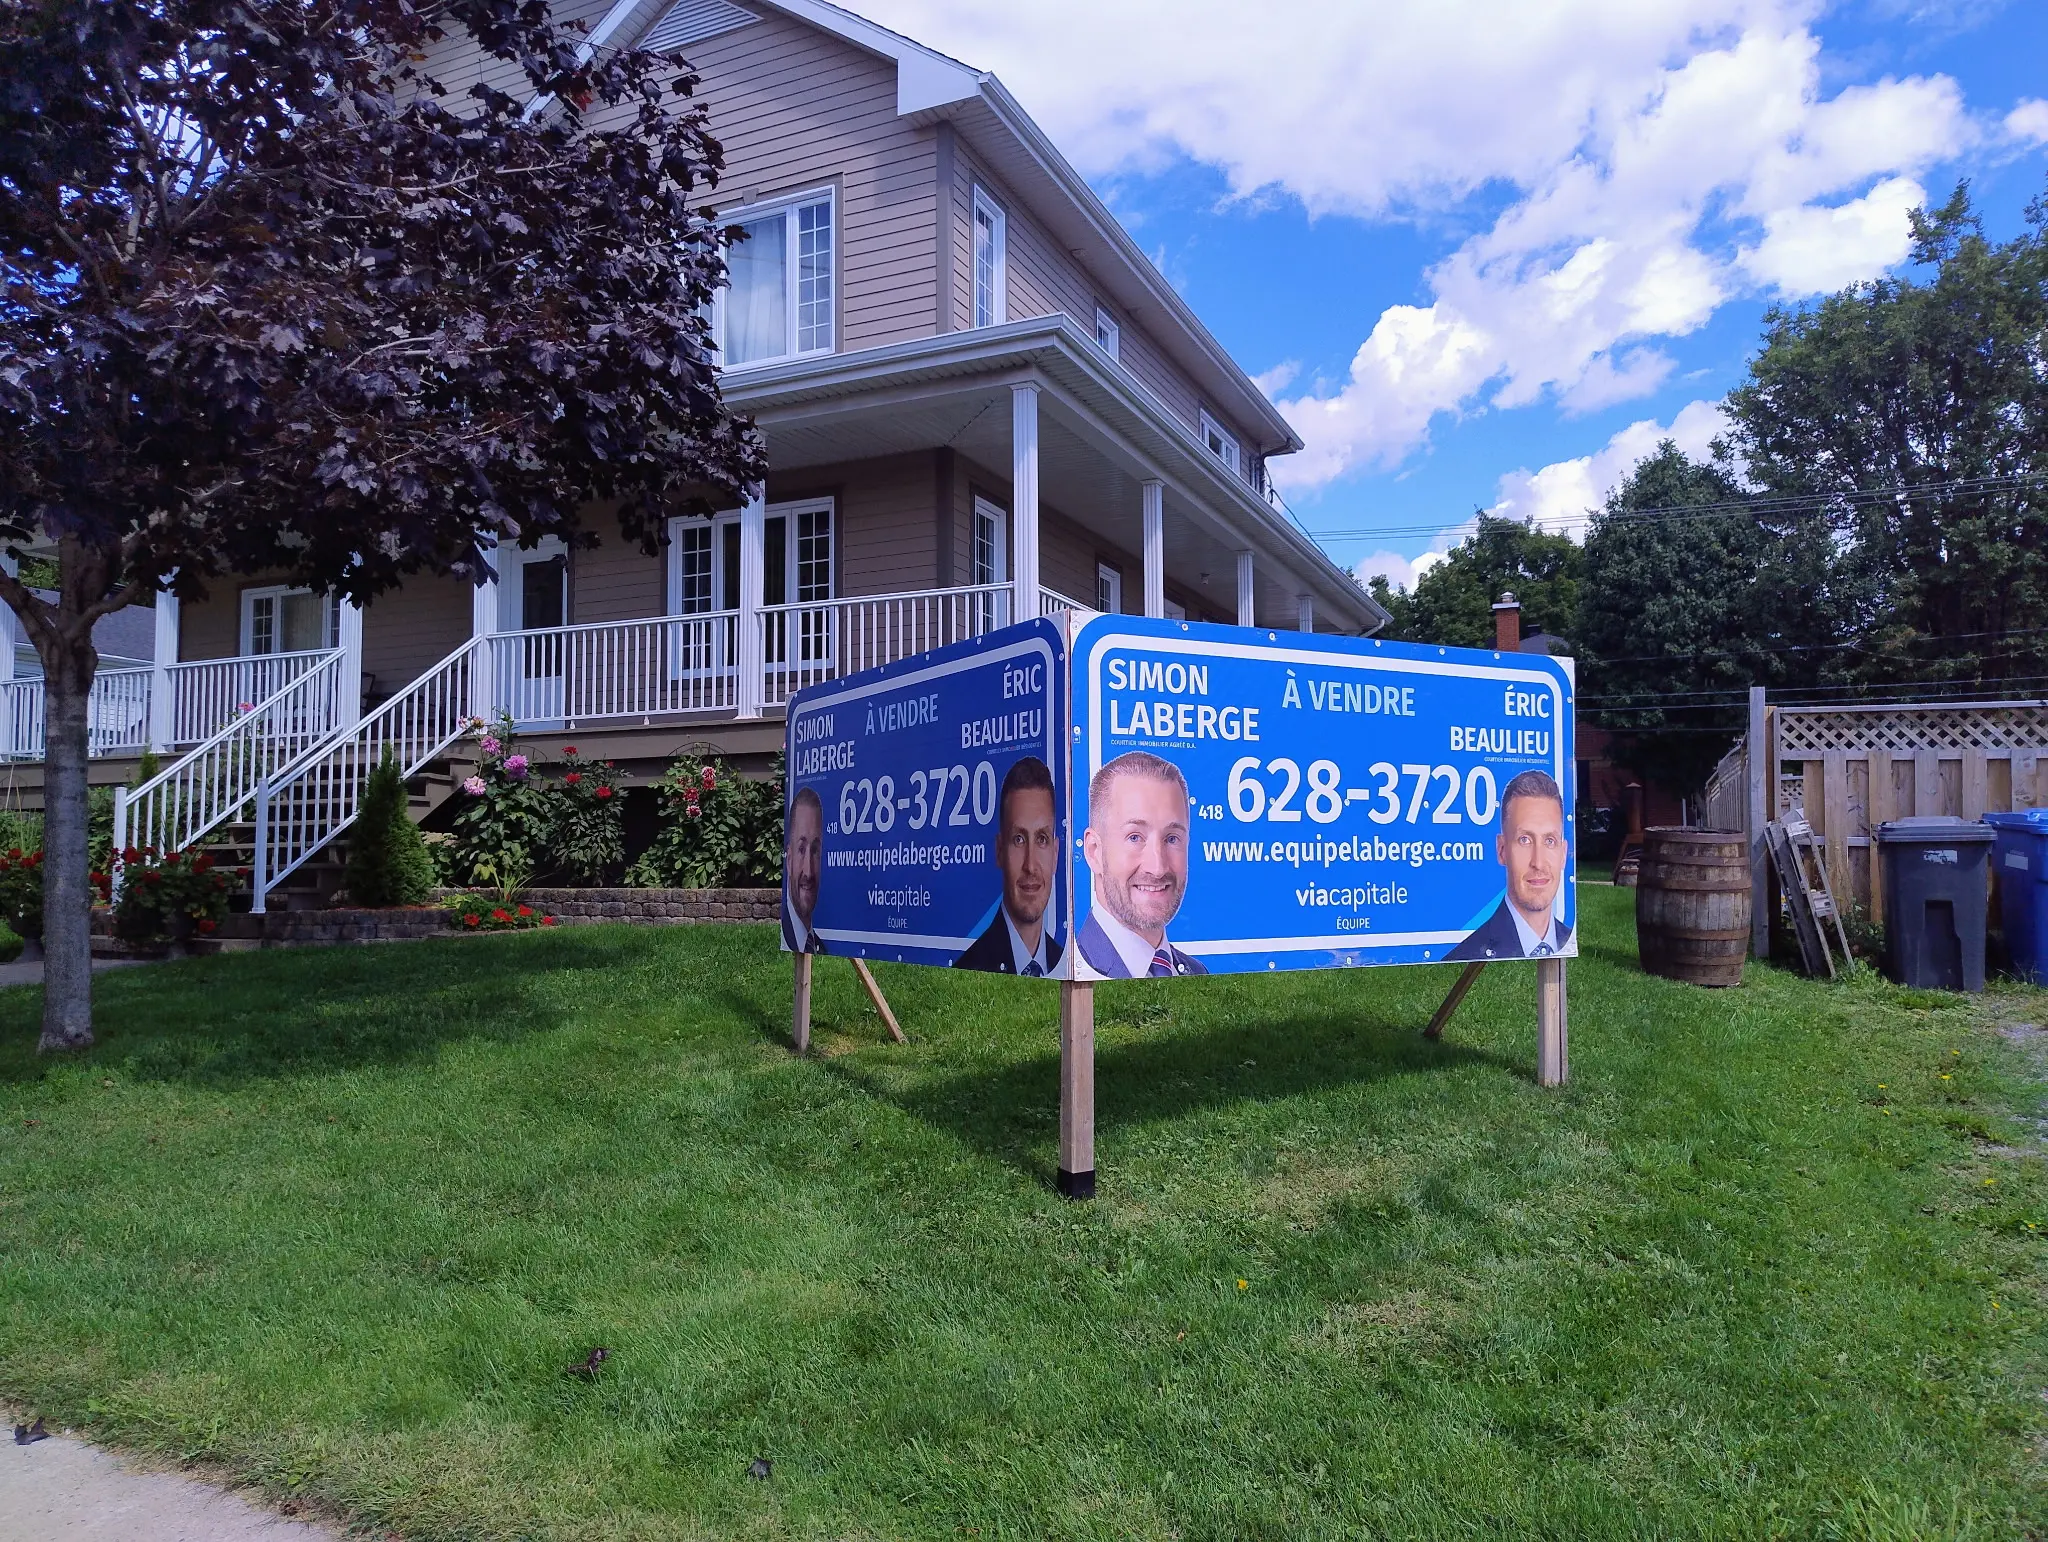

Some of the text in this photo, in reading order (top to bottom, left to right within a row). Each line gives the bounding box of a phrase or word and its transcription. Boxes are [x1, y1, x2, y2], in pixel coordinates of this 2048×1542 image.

[1003, 663, 1042, 700] ÉRIC
[1108, 658, 1208, 696] SIMON
[1281, 669, 1416, 717] À VENDRE
[865, 693, 939, 737] À VENDRE
[1504, 684, 1549, 718] ÉRIC
[796, 713, 834, 744] SIMON
[961, 708, 1042, 749] BEAULIEU
[1109, 699, 1260, 741] LABERGE
[1450, 726, 1549, 755] BEAULIEU
[796, 740, 855, 777] LABERGE
[826, 760, 996, 835] 418 628-3720
[1198, 756, 1496, 825] 418 628-3720
[827, 840, 985, 871] www.equipelaberge.com
[1203, 834, 1484, 868] www.equipelaberge.com
[867, 883, 931, 913] viacapitale
[1295, 881, 1408, 912] viacapitale
[887, 916, 908, 929] ÉQUIPE
[1336, 915, 1371, 930] ÉQUIPE
